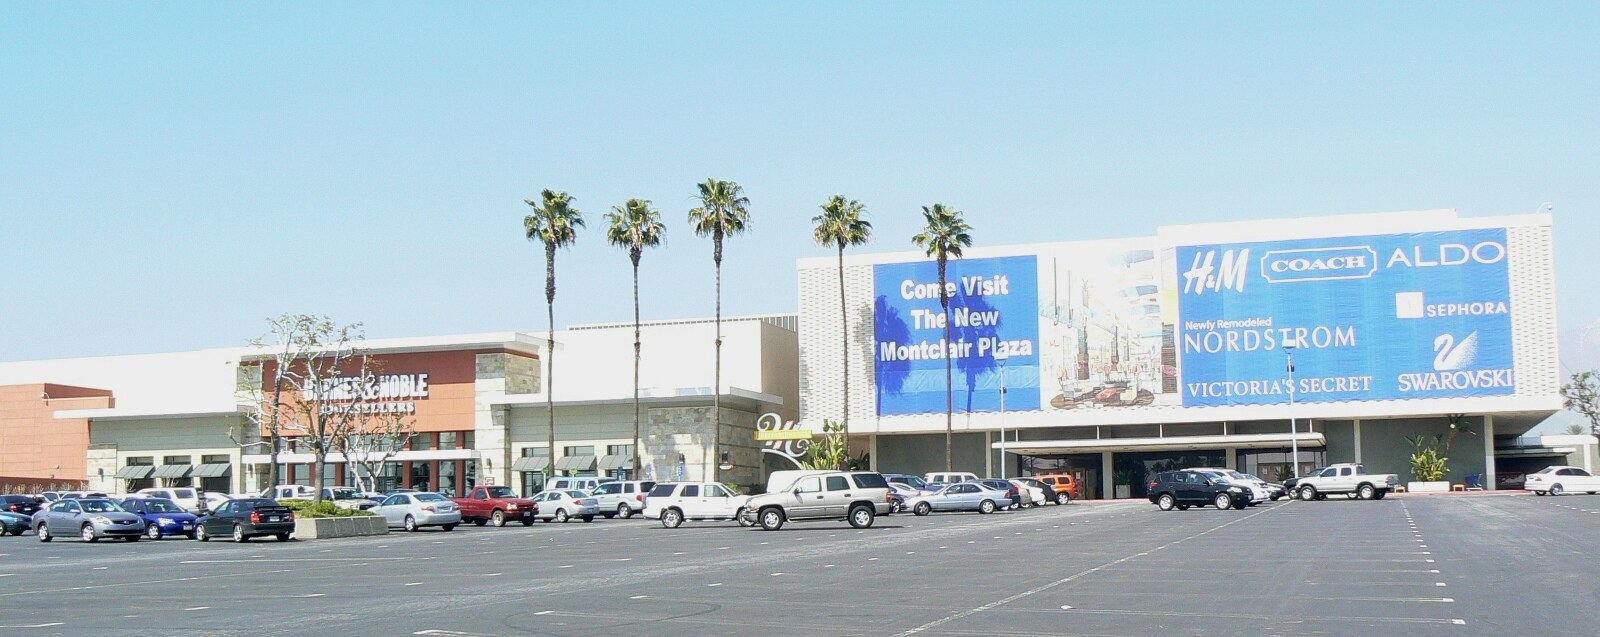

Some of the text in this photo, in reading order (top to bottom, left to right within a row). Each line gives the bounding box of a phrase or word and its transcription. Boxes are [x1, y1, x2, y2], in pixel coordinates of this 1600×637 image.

[1271, 256, 1367, 272] COACH
[1386, 241, 1505, 268] ALDO
[1183, 248, 1249, 295] H&M
[901, 275, 1008, 300] Come Visit
[911, 307, 999, 329] The New
[1427, 302, 1508, 317] SEPHORA
[1185, 317, 1272, 331] Newly Remodeled
[881, 337, 1032, 361] Montclair Plaza
[1185, 326, 1356, 354] NORDSTROM
[380, 374, 428, 398] NOBLE
[1187, 376, 1372, 397] VICTORIA'S SECRET
[1398, 369, 1514, 391] SWAROVSKI
